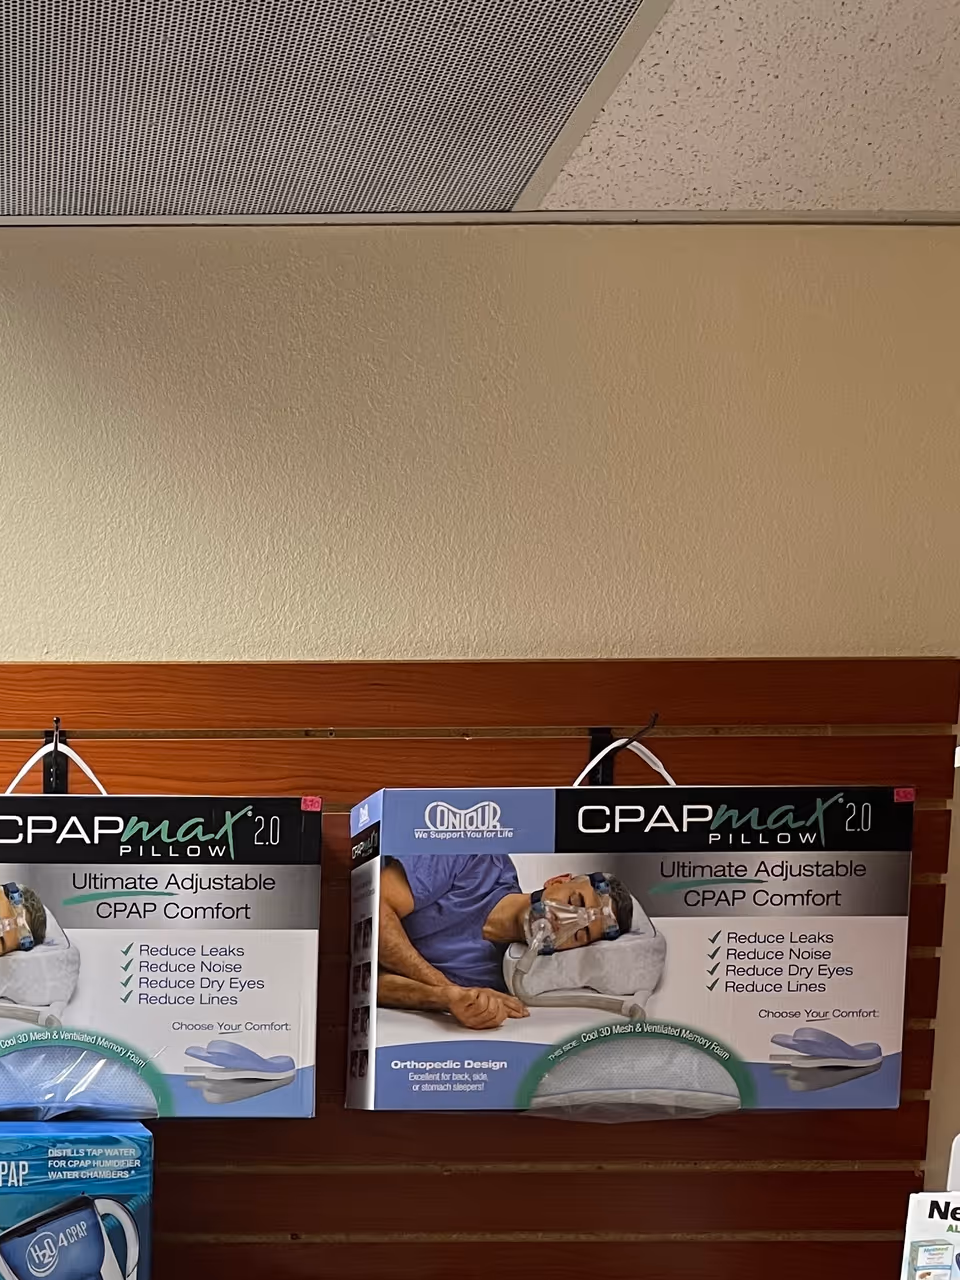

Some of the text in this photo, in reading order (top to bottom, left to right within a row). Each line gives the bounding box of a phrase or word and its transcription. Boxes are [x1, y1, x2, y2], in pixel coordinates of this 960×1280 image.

[424, 800, 501, 830] CONTOUR
[845, 802, 872, 832] 2.0
[253, 815, 281, 846] 2.0
[414, 830, 513, 840] We Support You for Life
[708, 832, 817, 844] PILLOW
[119, 845, 227, 857] PILLOW
[660, 860, 867, 881] Ultimate Adjustable
[72, 872, 277, 893] Ultimate Adjustable
[683, 889, 842, 908] CPAP Comfort
[96, 902, 252, 920] CPAP Comfort
[726, 931, 834, 944] Reduce Leaks
[139, 944, 245, 957] Reduce Leaks
[726, 948, 832, 960] Reduce Noise
[138, 960, 242, 973] Reduce Noise
[725, 964, 853, 979] Reduce Dry Eyes
[138, 976, 265, 992] Reduce Dry Eyes
[724, 981, 826, 993] Reduce Lines
[138, 993, 238, 1005] Reduce Lines
[758, 1008, 880, 1019] Choose Your Comfort:
[171, 1021, 292, 1032] Choose Your Comfort:
[581, 1022, 730, 1060] Cool 3D Mesh & Ventilated Memory Foam
[390, 1060, 508, 1071] Orthopedic Design
[48, 1148, 136, 1157] DISTILLS TAP WATER
[48, 1160, 141, 1168] FOR CPAP HUMIDIFIER
[47, 1171, 79, 1179] WATER
[58, 1233, 68, 1247] 4
[66, 1220, 88, 1244] CPAP
